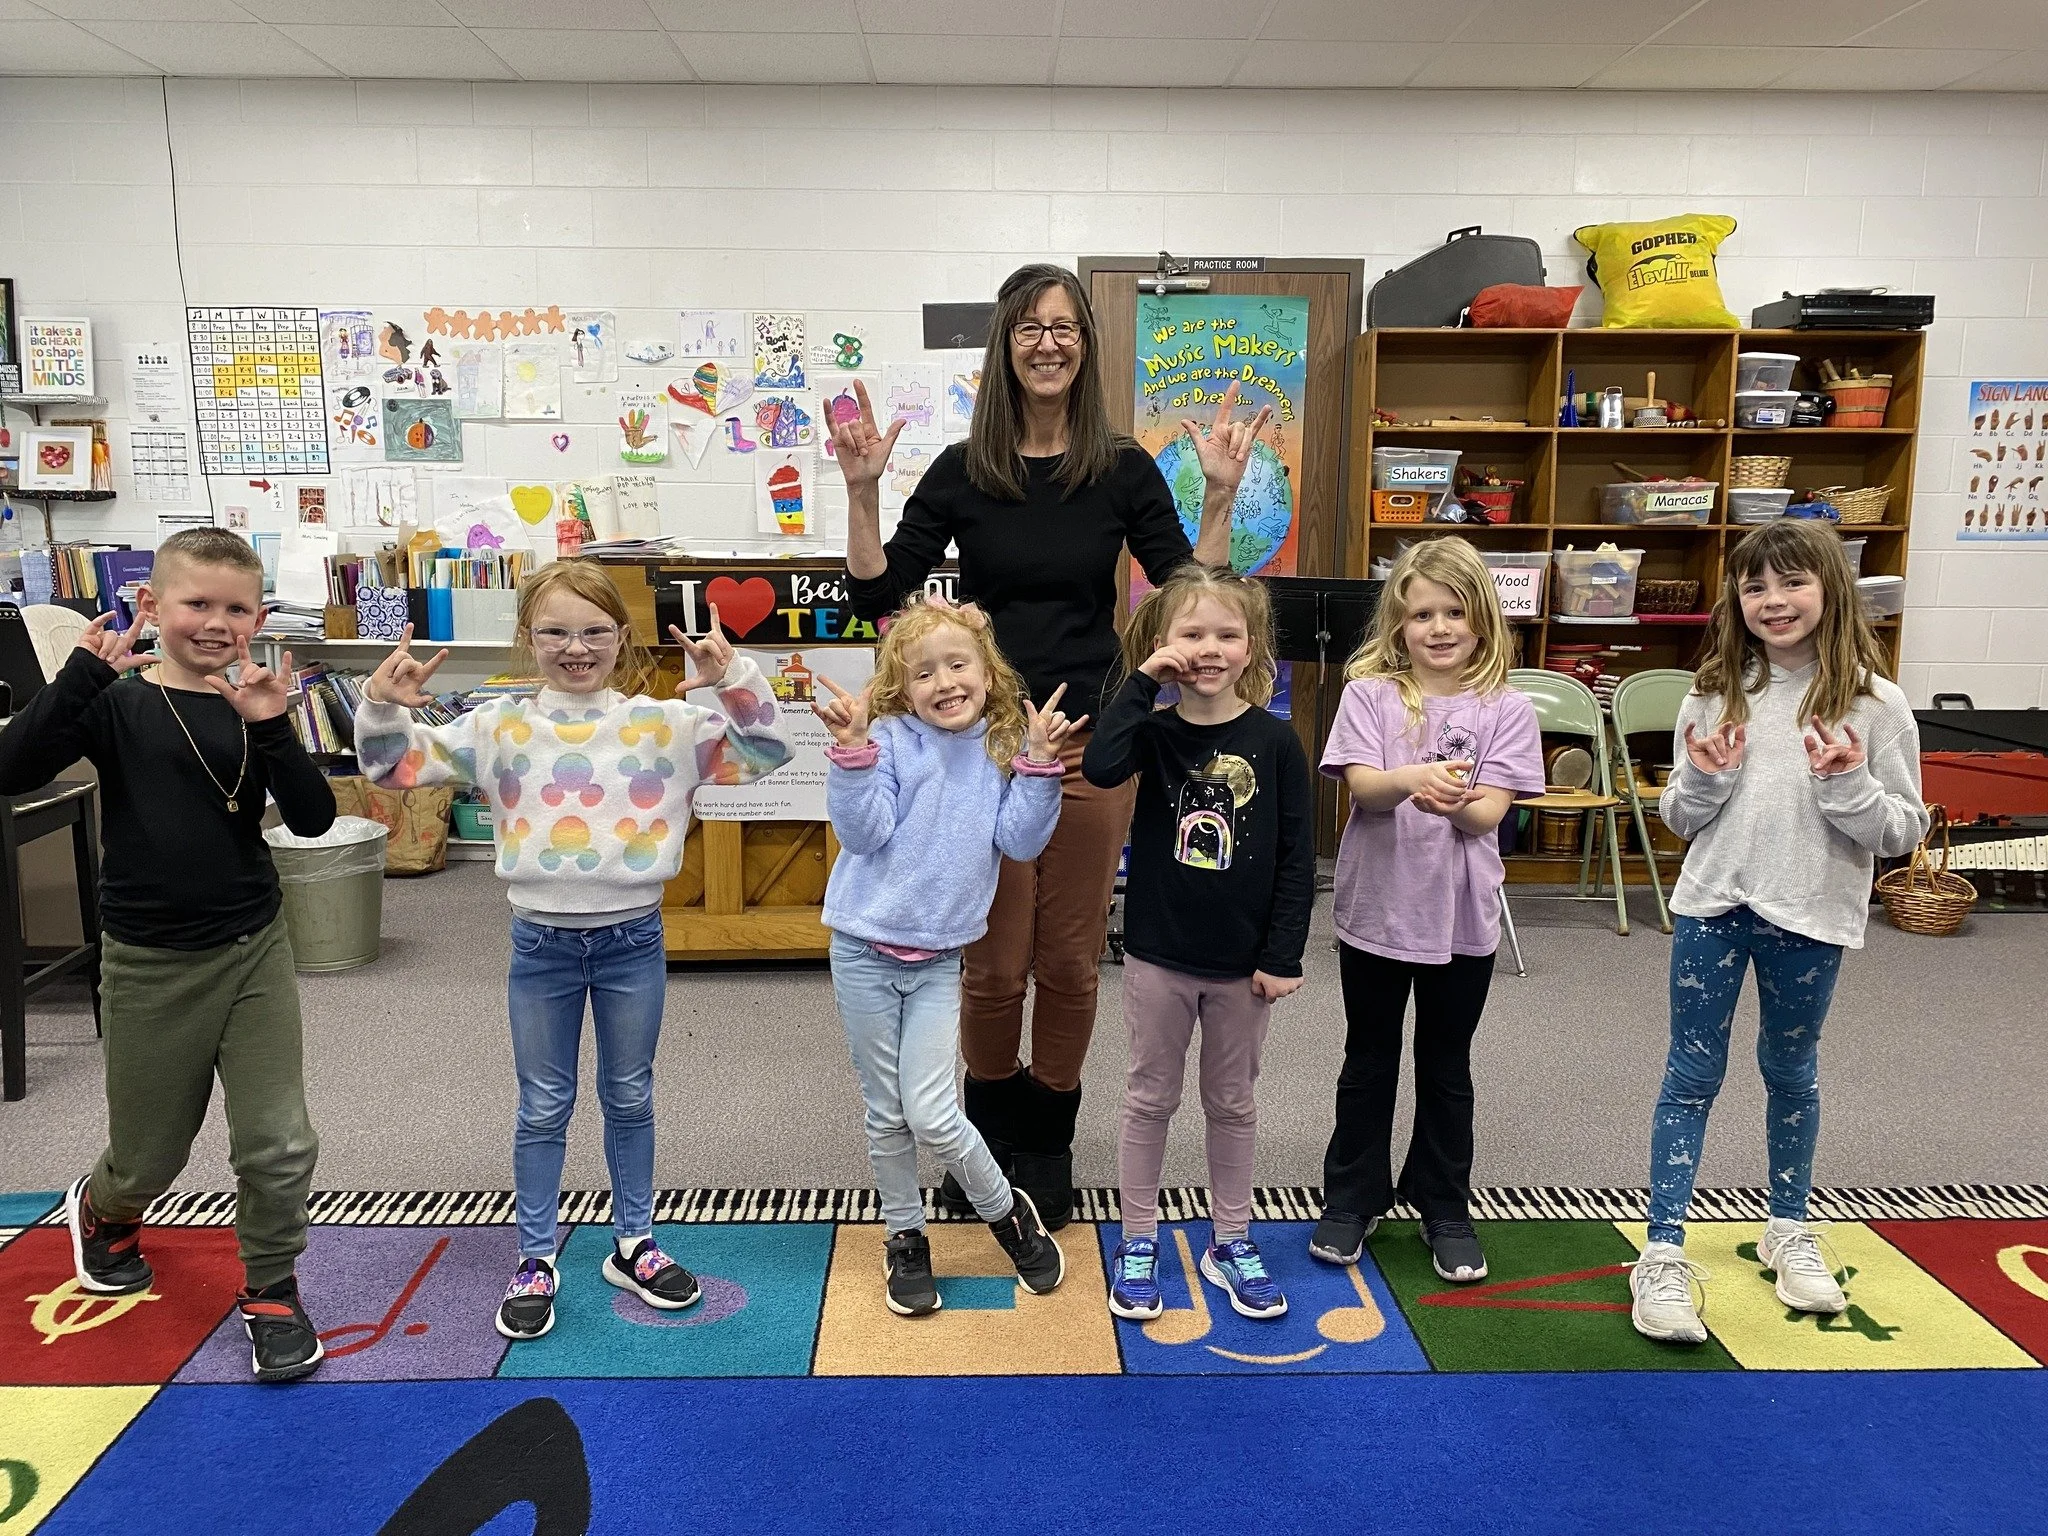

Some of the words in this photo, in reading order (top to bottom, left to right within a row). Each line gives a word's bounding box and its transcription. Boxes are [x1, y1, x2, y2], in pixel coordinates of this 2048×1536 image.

[1631, 232, 1697, 255] GOPHER
[1194, 260, 1231, 269] PRACTICE
[1236, 260, 1258, 269] ROOM
[215, 311, 222, 319] M
[236, 311, 244, 319] T
[258, 311, 266, 319] W
[300, 311, 306, 320] F
[30, 326, 38, 336] it
[41, 326, 72, 336] takes
[75, 328, 82, 336] a
[1153, 324, 1176, 344] We
[1182, 319, 1206, 333] are
[1211, 318, 1236, 331] the
[30, 338, 47, 346] BIG
[49, 338, 83, 346] HEART
[32, 348, 44, 357] to
[46, 347, 84, 359] shape
[1144, 343, 1204, 377] Music
[1213, 333, 1297, 366] Makers
[32, 360, 84, 371] LITTLE
[32, 373, 85, 386] MINDS
[1143, 377, 1168, 396] And
[1168, 372, 1188, 385] we
[1191, 368, 1212, 380] are
[1214, 367, 1239, 380] the
[1241, 364, 1295, 421] Dreamers
[1173, 392, 1190, 407] of
[1193, 387, 1253, 406] Dreas...
[1977, 384, 2013, 401] SIGN
[899, 469, 924, 477] Music
[1392, 467, 1446, 480] Shakers
[1654, 495, 1709, 507] Maracas
[1493, 574, 1530, 587] Wood
[669, 580, 710, 637] I
[790, 574, 849, 605] Bei
[1501, 596, 1532, 610] ocks
[777, 608, 892, 639] TEA
